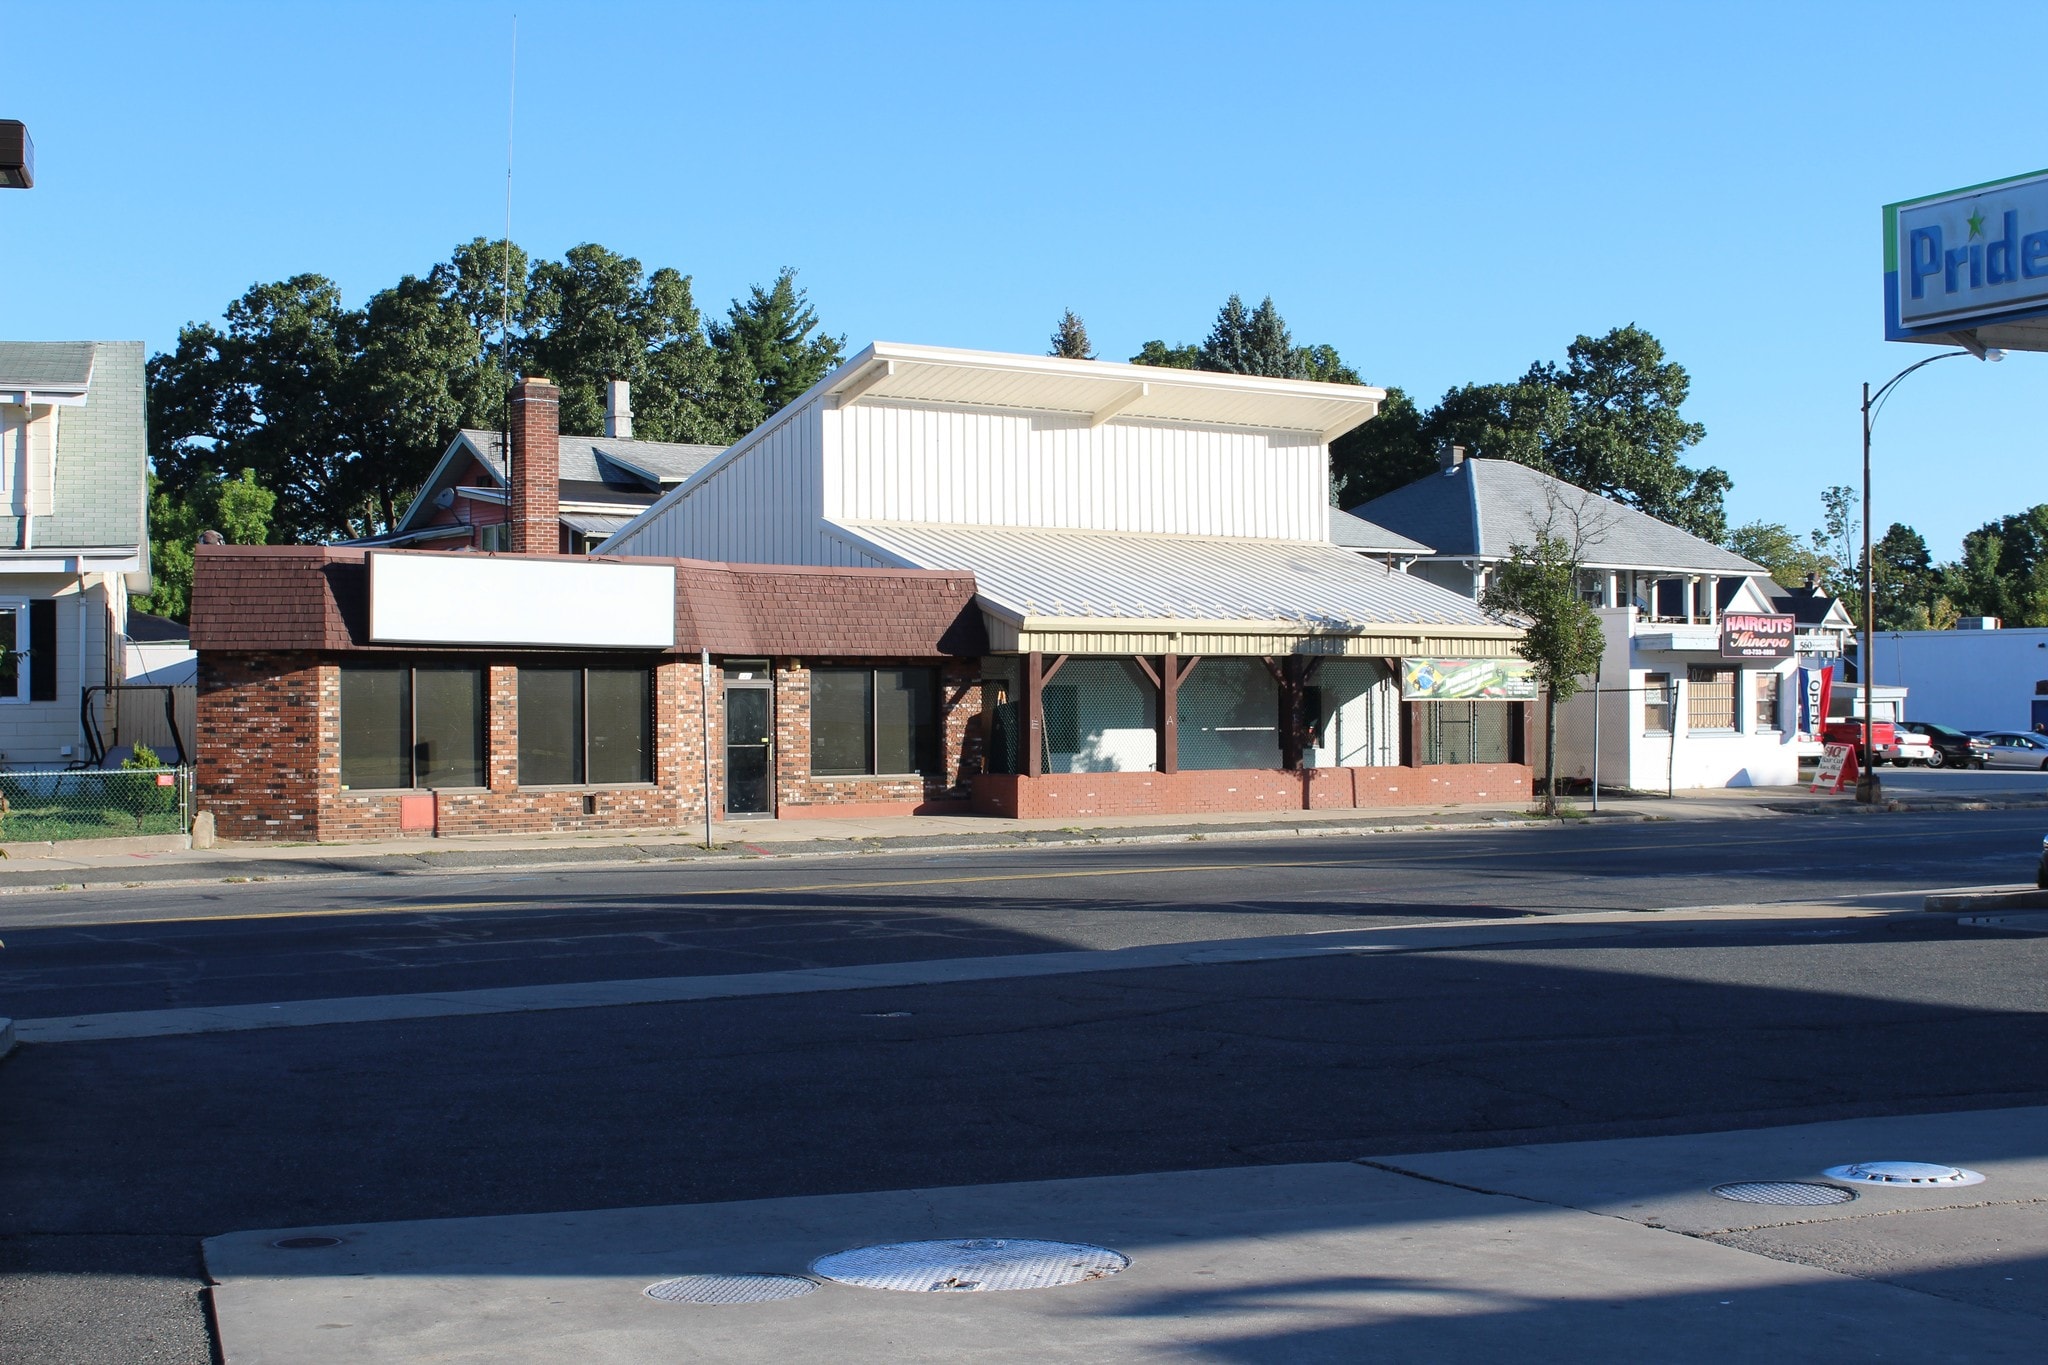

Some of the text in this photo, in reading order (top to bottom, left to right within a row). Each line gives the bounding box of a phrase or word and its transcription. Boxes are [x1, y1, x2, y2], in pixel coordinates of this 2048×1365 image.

[1910, 209, 2048, 300] Pride
[1726, 616, 1792, 633] HAIRCUTS
[1730, 632, 1790, 648] Minerva
[1809, 680, 1821, 725] OPEN
